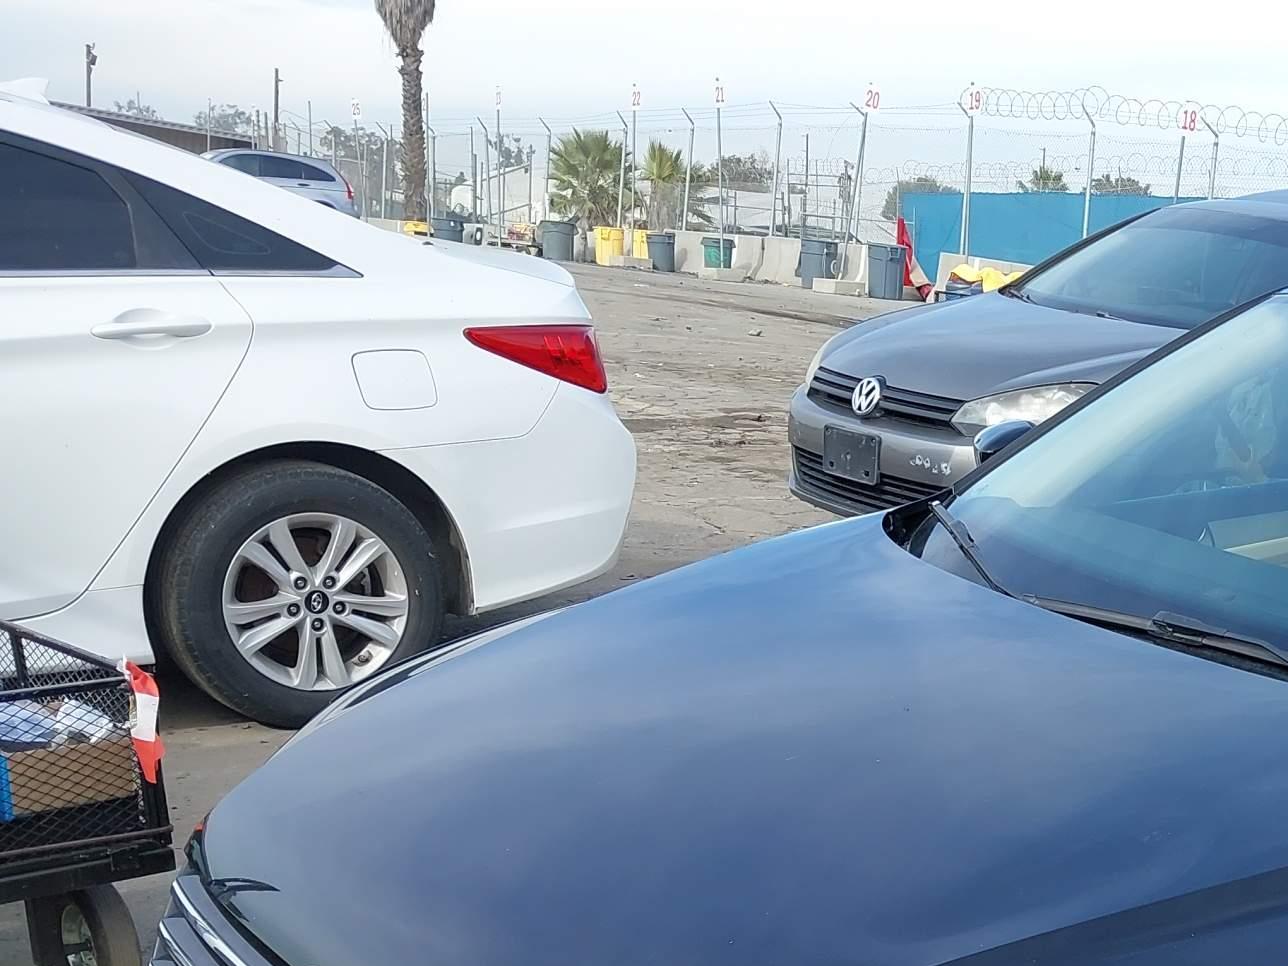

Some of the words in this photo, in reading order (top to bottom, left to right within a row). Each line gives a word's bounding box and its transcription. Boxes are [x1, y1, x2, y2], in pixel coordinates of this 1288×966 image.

[632, 90, 641, 106] 22
[715, 86, 725, 103] 21
[865, 89, 880, 109] 20
[968, 90, 981, 110] 19
[1181, 110, 1197, 131] 18
